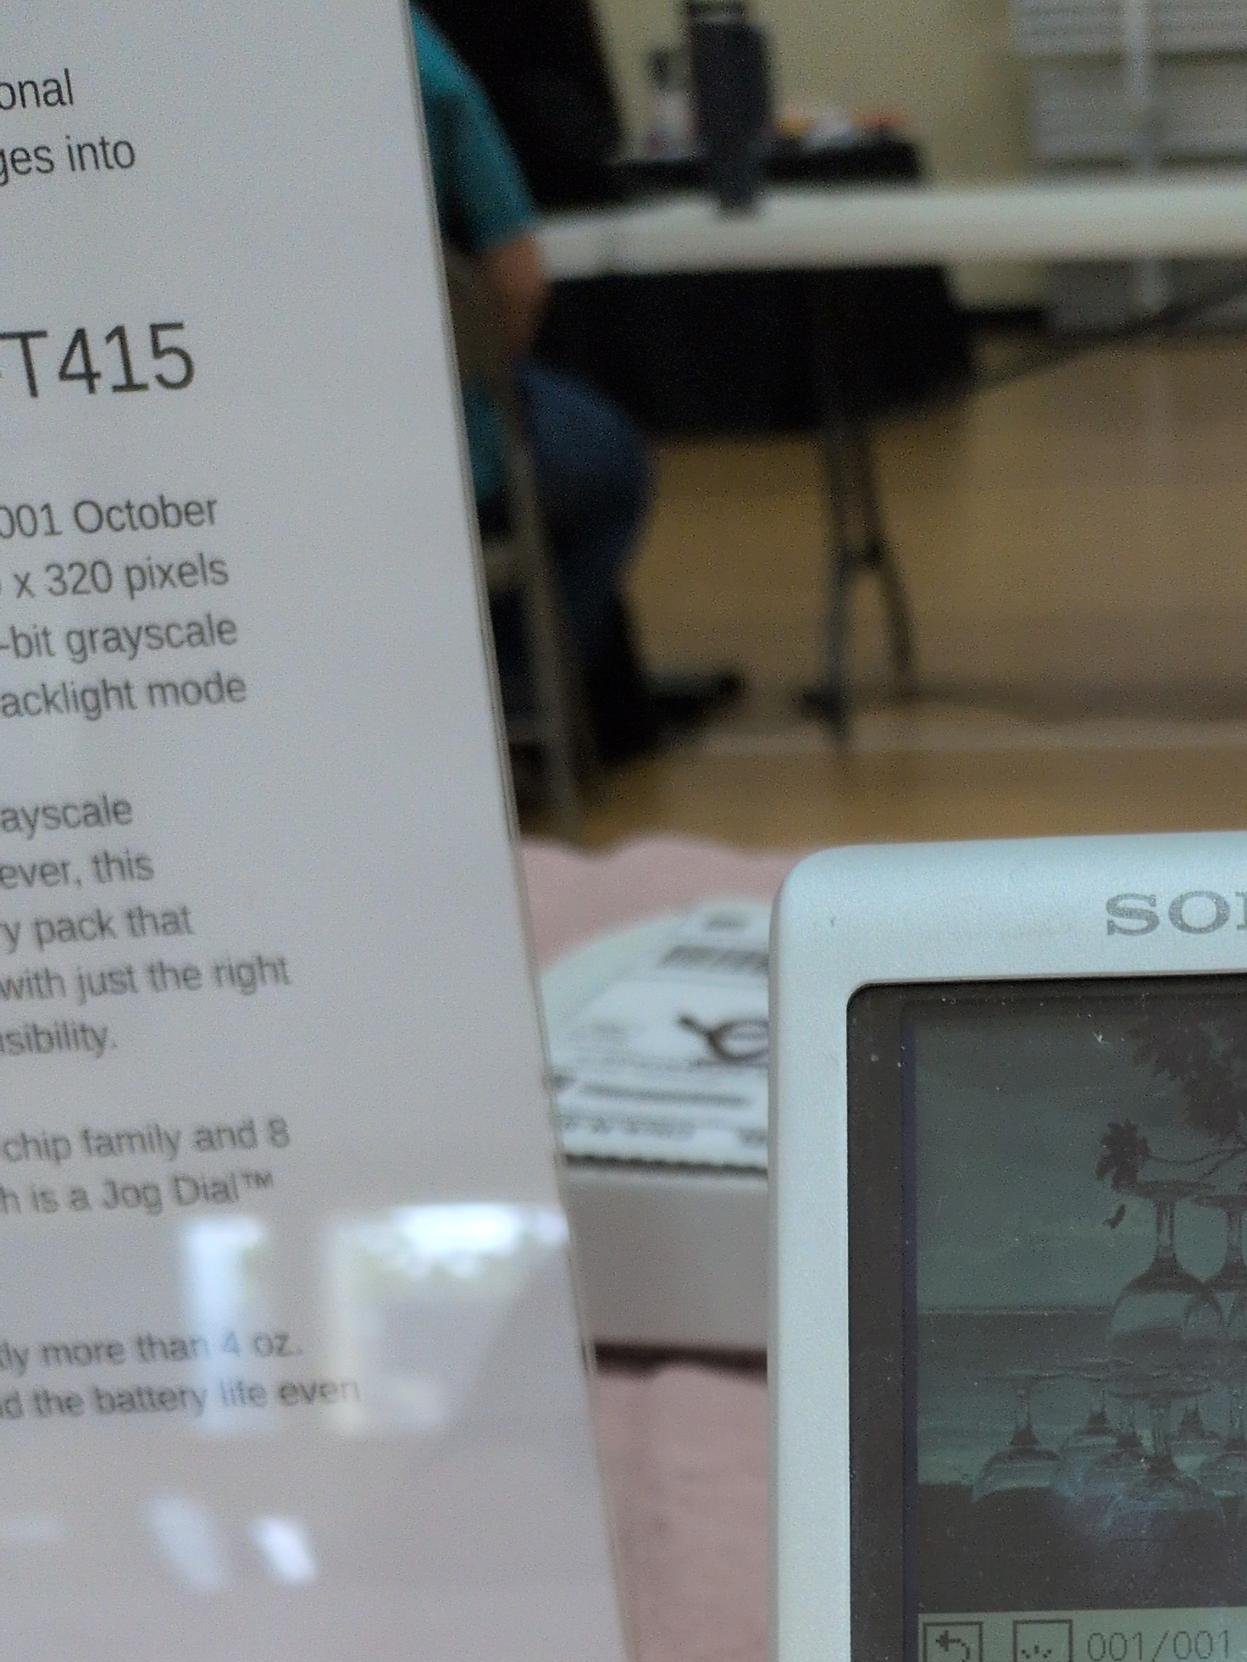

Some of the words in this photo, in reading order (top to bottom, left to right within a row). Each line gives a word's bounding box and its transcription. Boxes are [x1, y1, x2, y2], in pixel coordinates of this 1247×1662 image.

[65, 135, 136, 172] into
[73, 495, 218, 534] October
[13, 571, 36, 599] x
[46, 559, 113, 597] 320
[125, 553, 230, 601] pixels
[66, 613, 238, 664] grayscale
[1, 679, 138, 722] acklight
[147, 672, 247, 707] mode
[0, 794, 134, 840] ayscale
[91, 850, 155, 884] this
[34, 908, 117, 951] pack
[125, 905, 196, 939] that
[0, 967, 67, 1001] with
[76, 963, 138, 1006] just
[147, 958, 203, 993] the
[214, 954, 291, 996] right
[3, 1131, 72, 1165] chip
[80, 1123, 182, 1162] family
[195, 1117, 258, 1152] and
[266, 1115, 291, 1149] 8
[31, 1183, 59, 1213] is
[69, 1185, 92, 1212] a
[103, 1177, 164, 1216] Jog
[39, 1338, 127, 1367] more
[136, 1332, 210, 1362] than
[33, 1385, 86, 1418] the
[93, 1380, 207, 1418] battery
